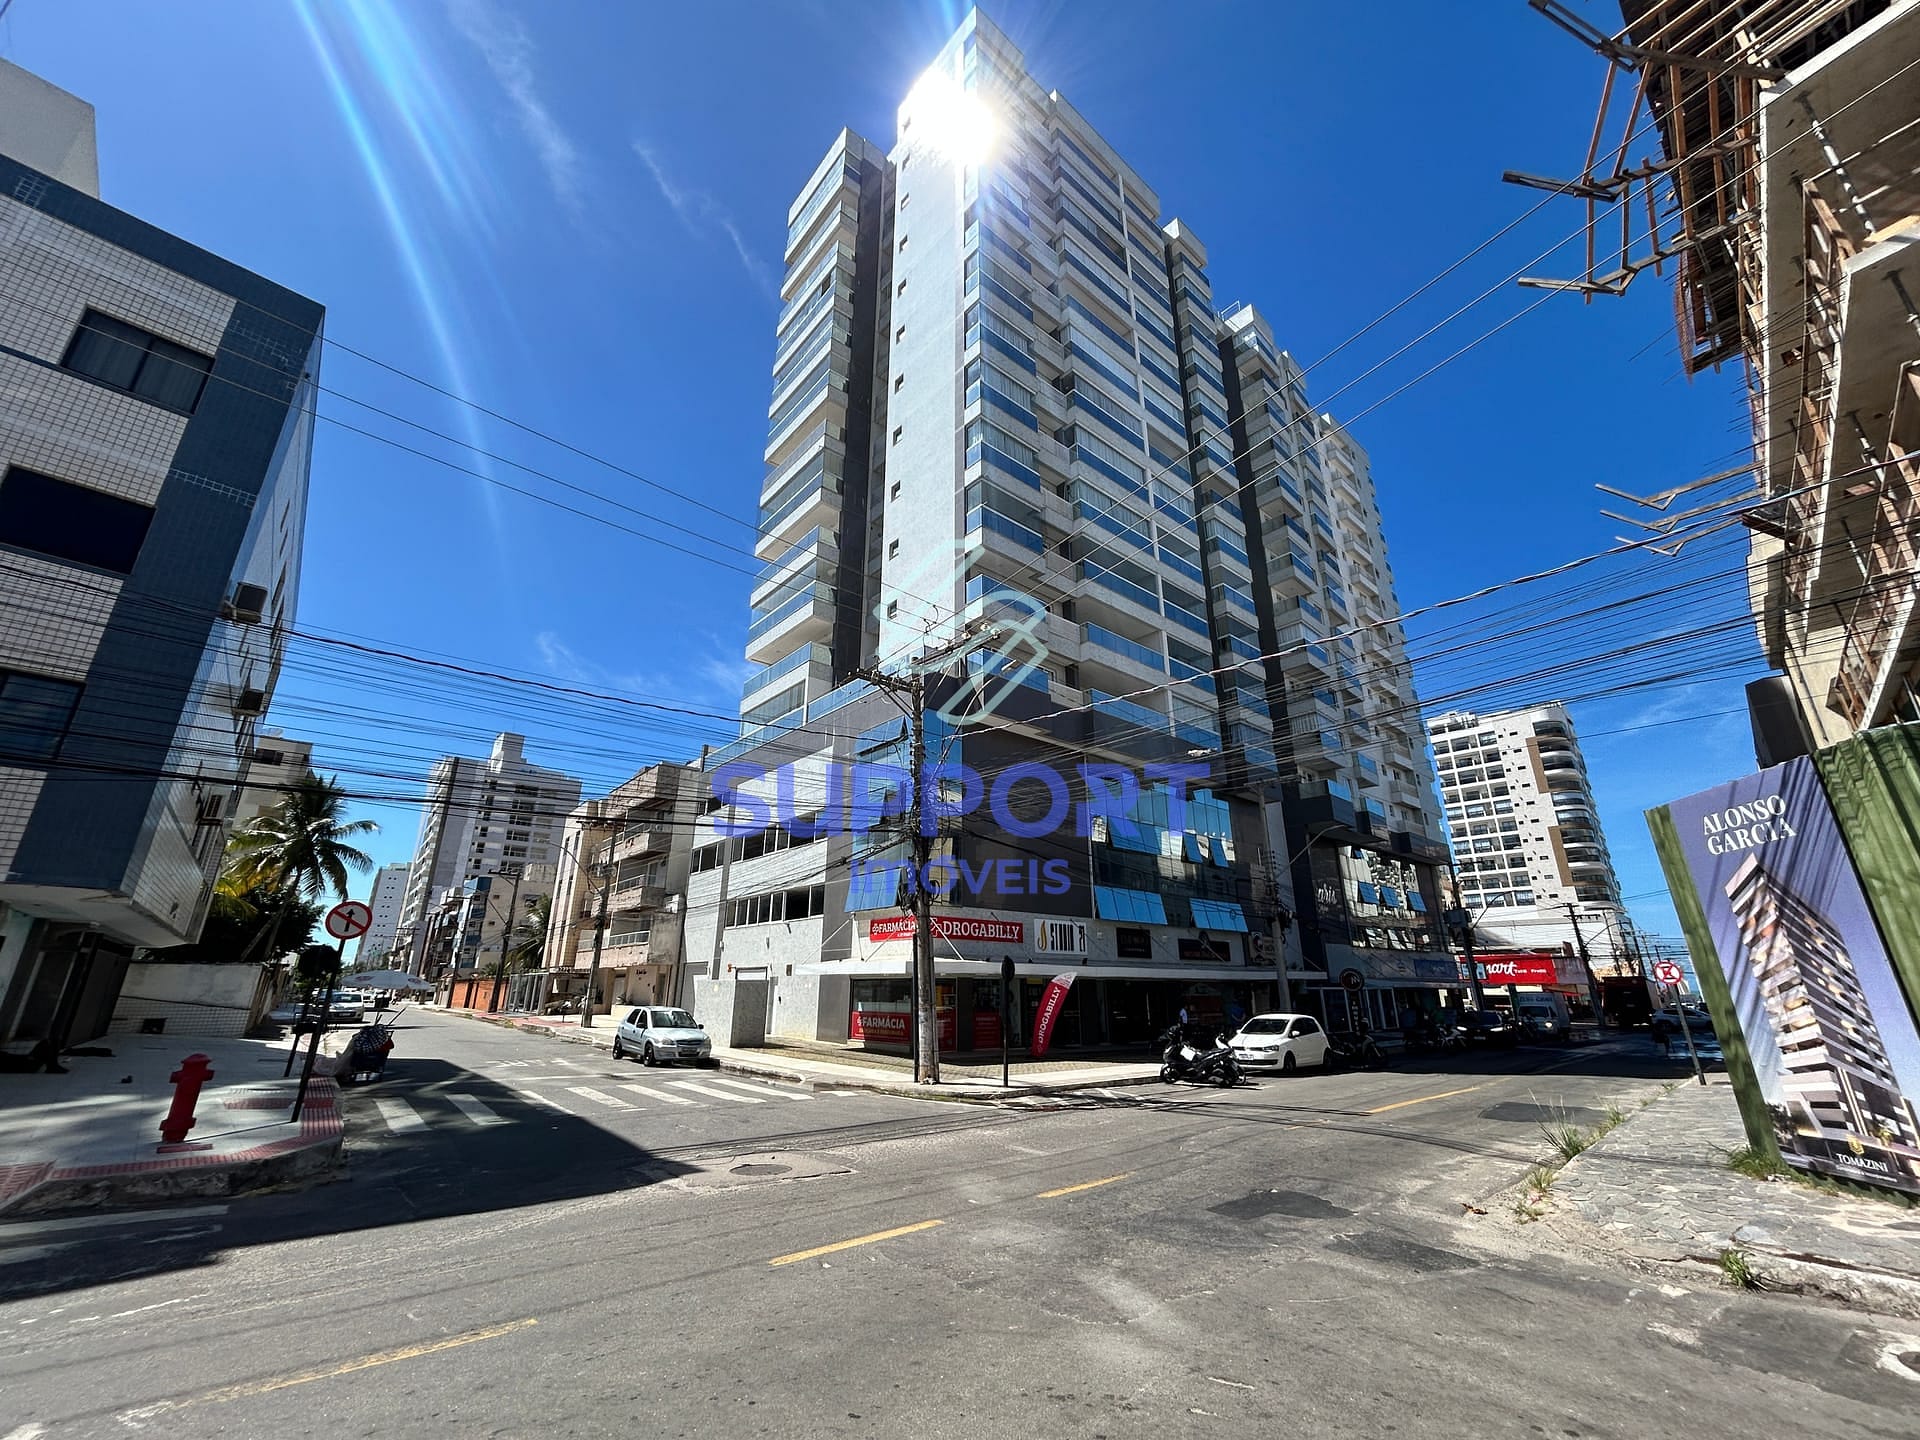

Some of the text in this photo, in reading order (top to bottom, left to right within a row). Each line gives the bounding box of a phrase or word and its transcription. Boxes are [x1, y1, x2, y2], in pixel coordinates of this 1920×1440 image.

[1703, 795, 1786, 835] ALONSO
[1707, 818, 1797, 855] GARCIA
[878, 919, 917, 934] FARMÁCIA
[943, 921, 1020, 939] DROGABILLY
[862, 1016, 905, 1030] FARMÁCIA
[1038, 986, 1062, 1044] DROGABILLY
[1836, 1153, 1888, 1172] TOMAZINI
